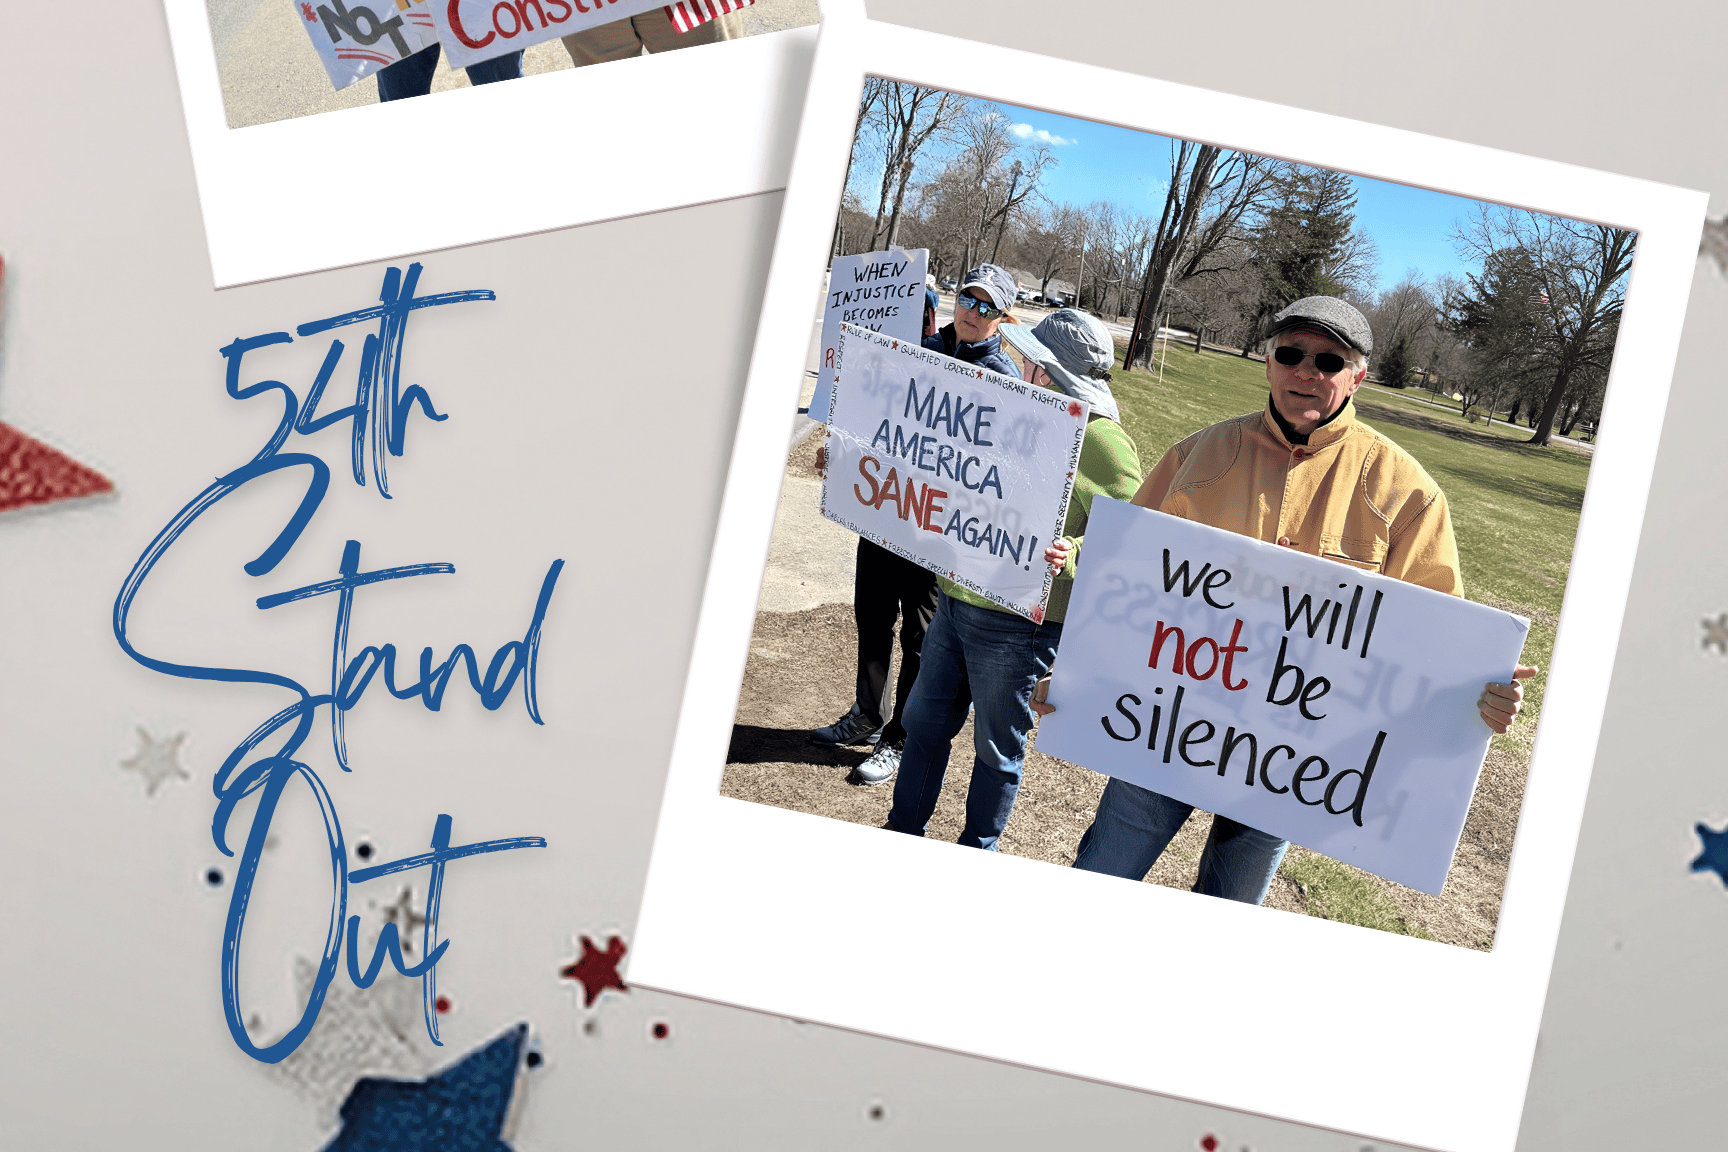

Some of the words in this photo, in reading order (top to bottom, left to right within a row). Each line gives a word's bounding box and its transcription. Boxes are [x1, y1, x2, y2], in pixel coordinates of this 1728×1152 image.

[854, 261, 908, 283] WHEN
[831, 282, 921, 309] INJUSTICE
[843, 306, 900, 322] BECOMES
[900, 344, 941, 366] QUALIFIED
[904, 377, 996, 447] MAKE
[985, 372, 1028, 396] IMMIGRANT
[1031, 389, 1068, 412] RIGHTS
[871, 419, 1003, 499] AMERICA
[1070, 426, 1084, 470] HUMANITY
[853, 455, 948, 534] SANE
[944, 508, 1038, 571] AGAIN!
[1058, 477, 1073, 518] SECURITY
[1162, 548, 1234, 610] we
[1282, 582, 1384, 658] will
[1148, 618, 1248, 691] not
[1266, 636, 1332, 720] be
[1101, 685, 1387, 827] silenced
